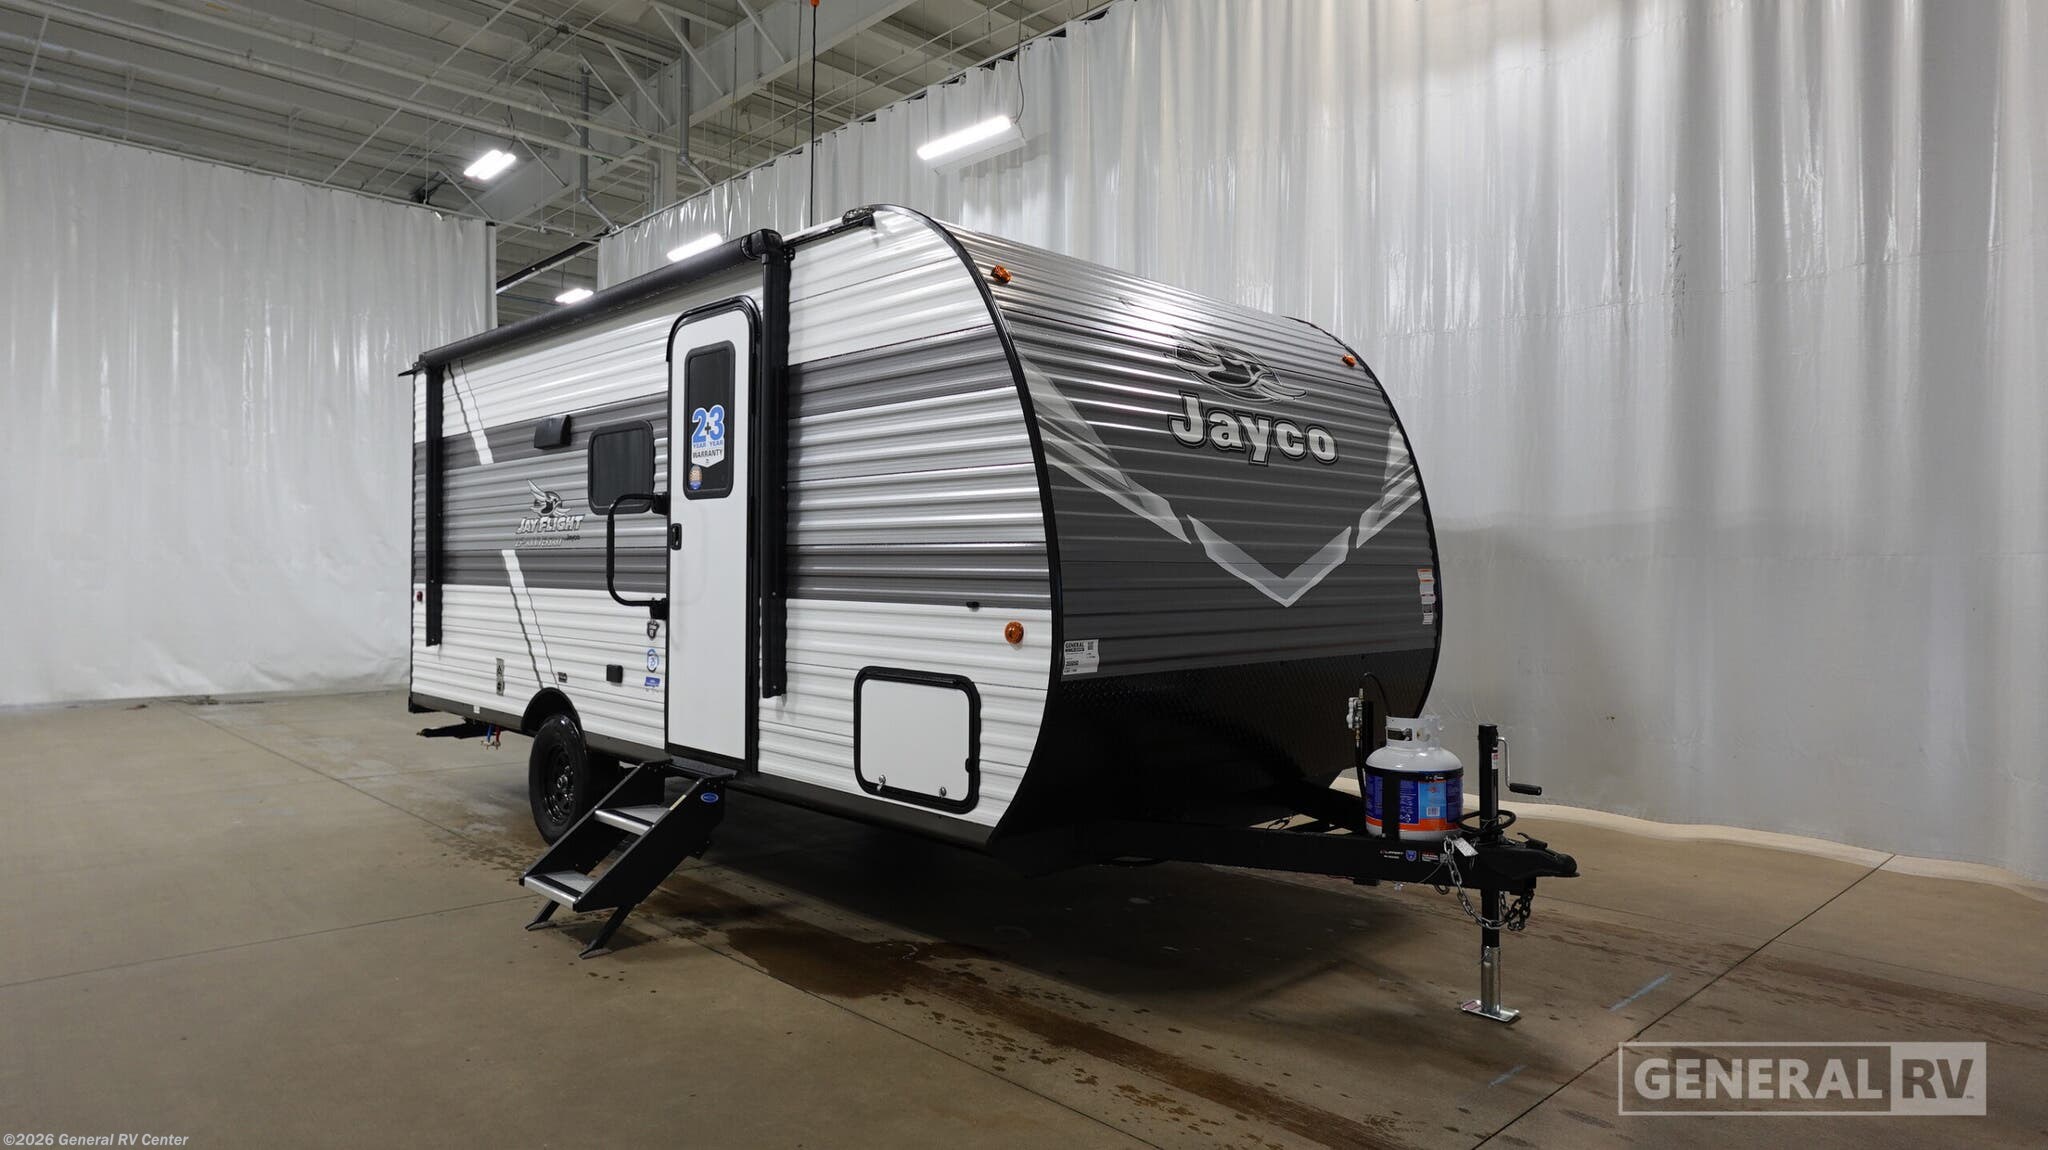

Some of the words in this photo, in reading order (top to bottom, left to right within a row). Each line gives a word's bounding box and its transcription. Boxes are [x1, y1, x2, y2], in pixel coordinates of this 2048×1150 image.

[1168, 390, 1339, 467] Jayco
[710, 439, 723, 447] YEAR
[692, 449, 723, 459] WARRANTY
[516, 517, 539, 534] JAY
[538, 514, 585, 532] FLIGHT
